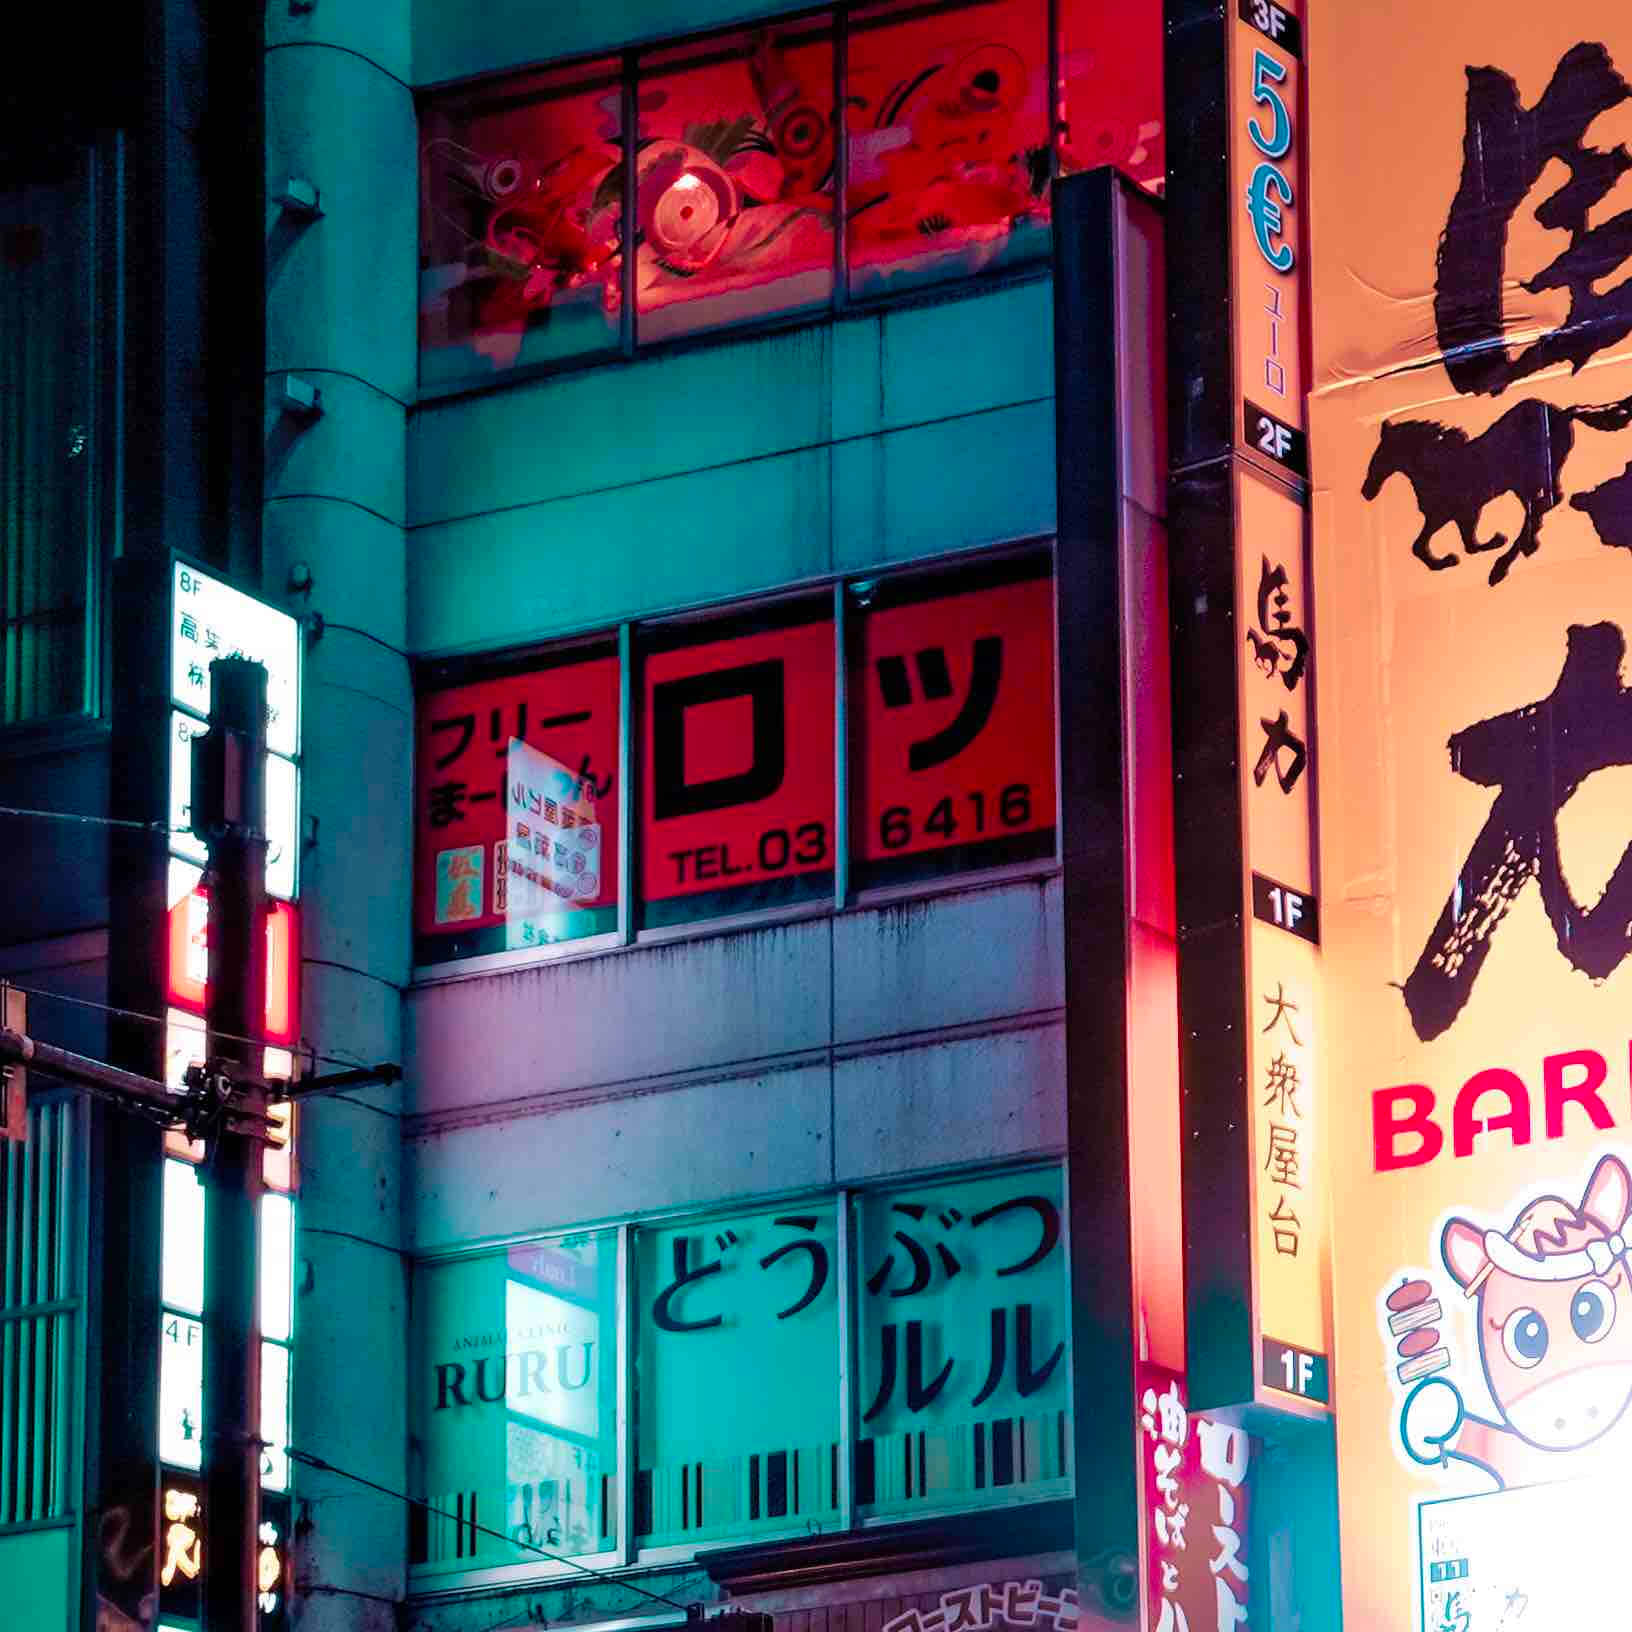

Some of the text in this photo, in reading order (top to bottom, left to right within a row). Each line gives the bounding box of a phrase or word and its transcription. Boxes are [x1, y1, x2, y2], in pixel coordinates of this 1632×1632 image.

[1251, 0, 1287, 37] 3F
[1246, 46, 1295, 273] 5€
[1262, 284, 1288, 398] ユーロ
[1256, 416, 1292, 457] 2F
[1247, 553, 1312, 796] 馬力
[431, 703, 592, 771] フリー
[880, 786, 1034, 850] 6416
[1268, 886, 1303, 925] 1F
[1261, 981, 1301, 1261] 大衆屋台
[651, 1194, 1061, 1334] どうぶつ
[165, 1319, 199, 1347] 4F
[864, 1302, 1067, 1425] ルル
[433, 1340, 596, 1412] RURU
[1278, 1353, 1316, 1392] 1F
